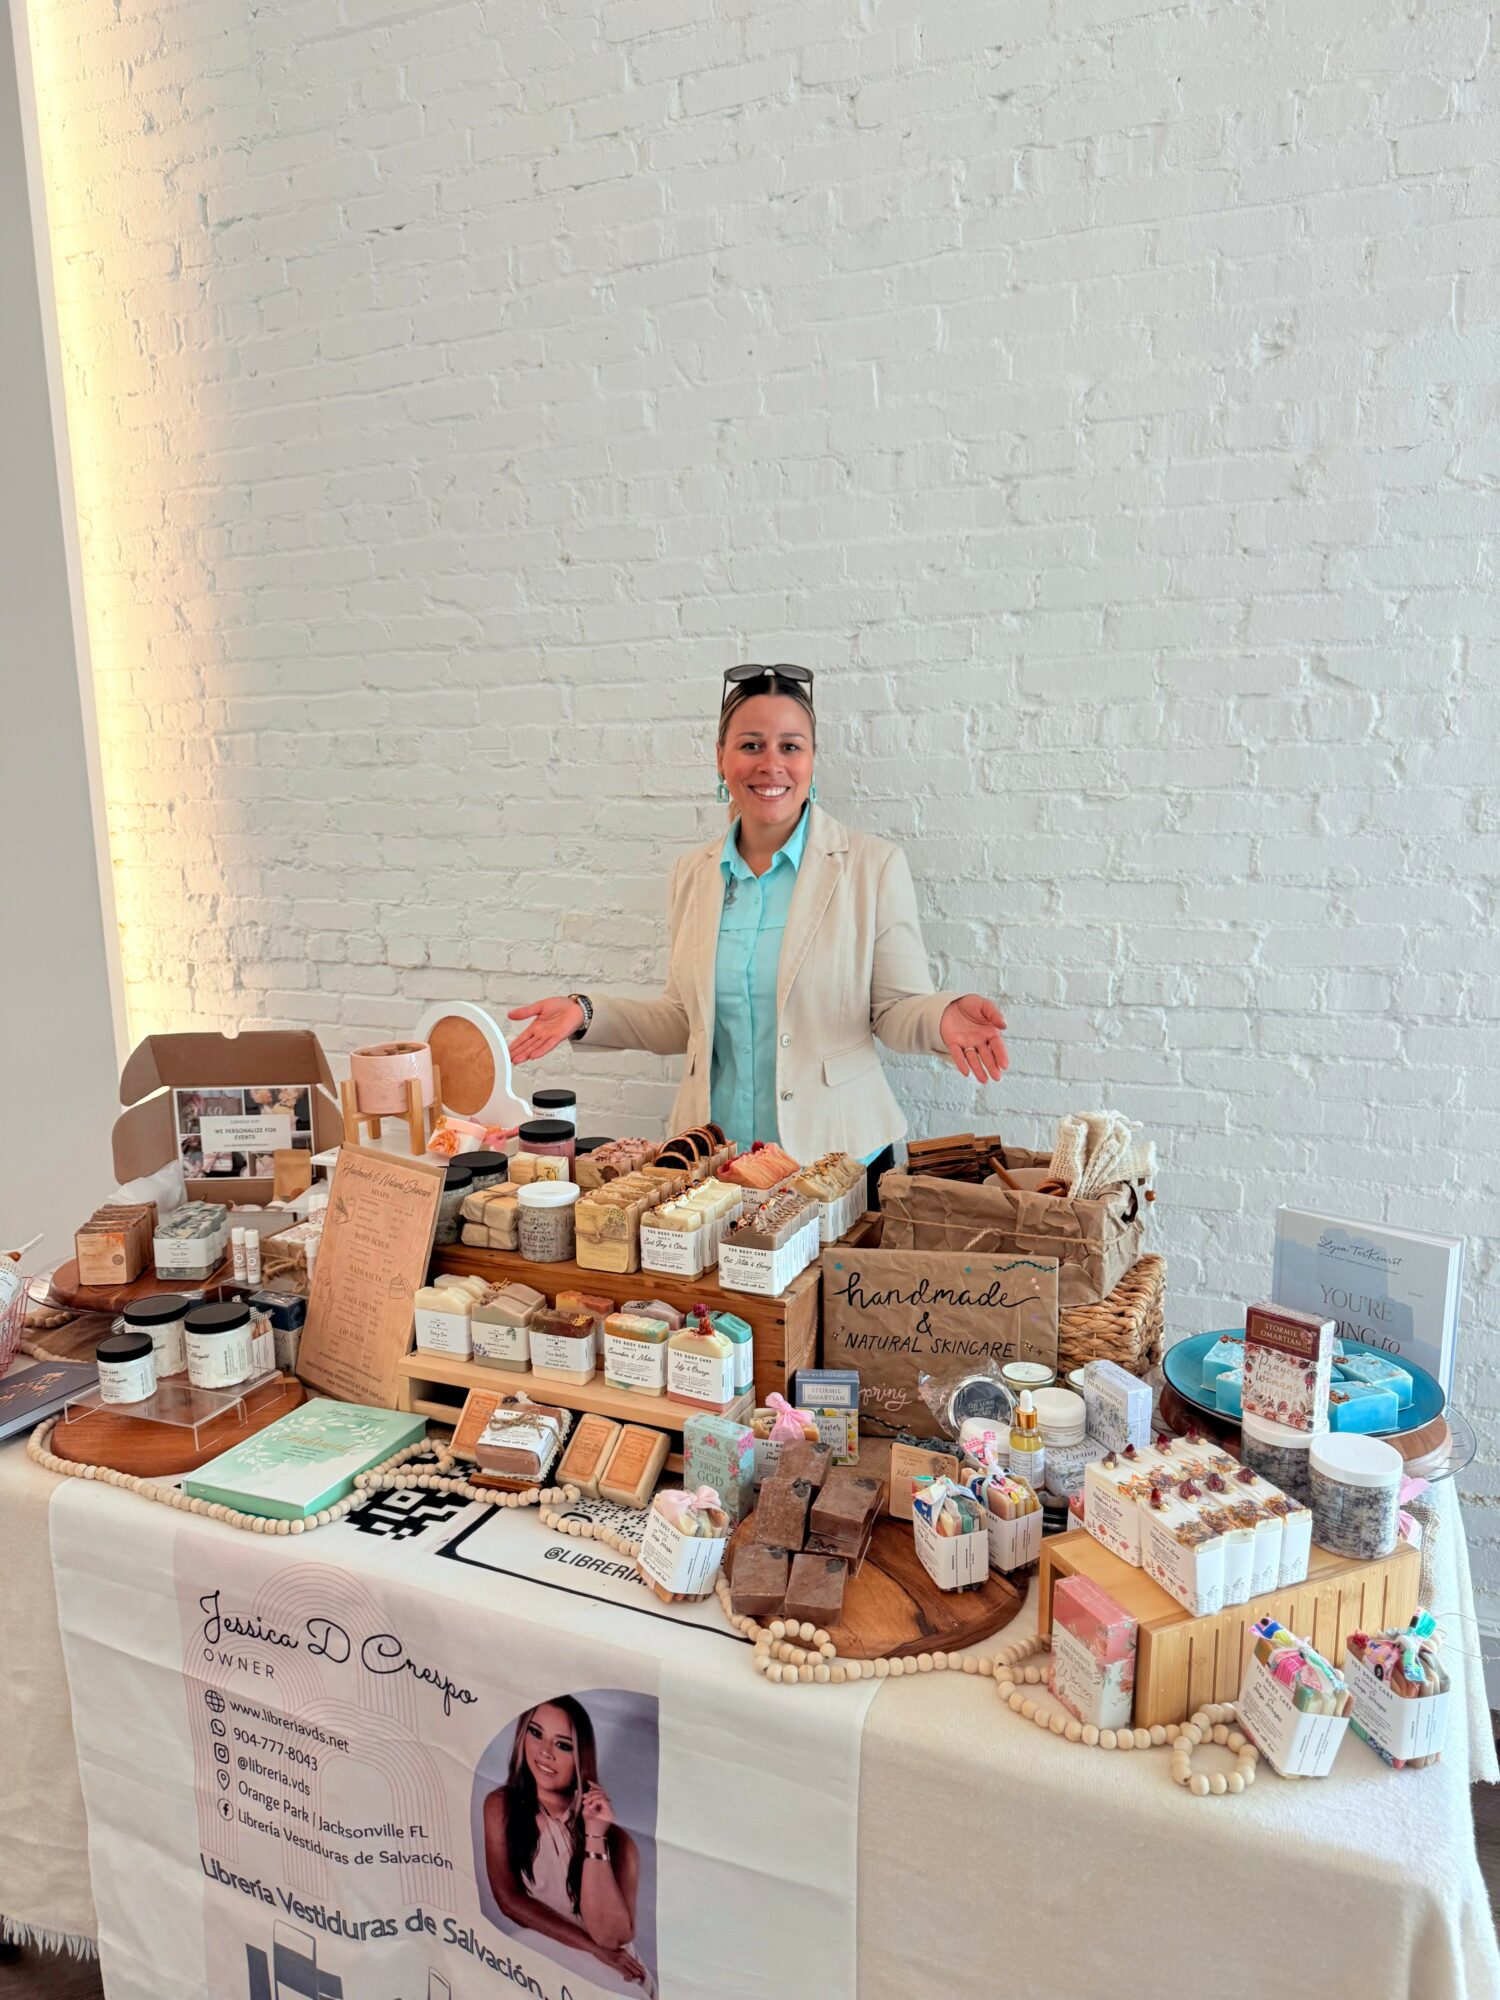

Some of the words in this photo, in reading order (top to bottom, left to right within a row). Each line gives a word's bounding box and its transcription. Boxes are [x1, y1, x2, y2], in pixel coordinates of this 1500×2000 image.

[1317, 1236, 1349, 1254] Lysa
[1350, 1245, 1402, 1266] TerKeurst
[832, 1271, 1040, 1310] handmade
[1320, 1284, 1393, 1323] YOU'RE
[916, 1311, 933, 1337] &
[1260, 1330, 1301, 1346] OMARTIAN
[1265, 1322, 1297, 1336] STORMIE
[1313, 1312, 1375, 1348] ING
[1383, 1335, 1400, 1354] to
[845, 1332, 922, 1353] NATURAL
[931, 1338, 1017, 1358] SKINCARE
[858, 1384, 912, 1411] pring
[697, 1470, 723, 1487] GOD
[700, 1462, 720, 1474] FROM
[544, 1546, 649, 1586] @LIBRERIA.
[200, 1590, 298, 1649] Jessica
[306, 1618, 351, 1663] D
[362, 1634, 478, 1716] Crespo
[203, 1648, 275, 1679] OWNER
[1253, 1681, 1265, 1701] Soap
[1266, 1698, 1283, 1723] Scraps
[1265, 1680, 1278, 1696] BODY
[1280, 1695, 1292, 1712] CARE
[1354, 1677, 1366, 1695] Soap
[1368, 1691, 1387, 1713] Scraps
[1363, 1672, 1377, 1685] BODY
[1379, 1686, 1393, 1700] CARE
[229, 1700, 350, 1754] www.libreriavds.net
[234, 1728, 318, 1771] 904-777-8043
[238, 1755, 311, 1796] @libreria.vds
[238, 1780, 280, 1812] Orange
[283, 1800, 309, 1822] Park
[318, 1816, 404, 1839] Jacksonville
[410, 1825, 429, 1838] FL
[238, 1809, 280, 1838] Librería
[283, 1828, 350, 1864] Vestiduras
[354, 1850, 374, 1864] de
[379, 1850, 453, 1870] Salvación
[200, 1853, 276, 1906] Librería
[276, 1887, 398, 1941] Vestiduras
[405, 1909, 437, 1936] de
